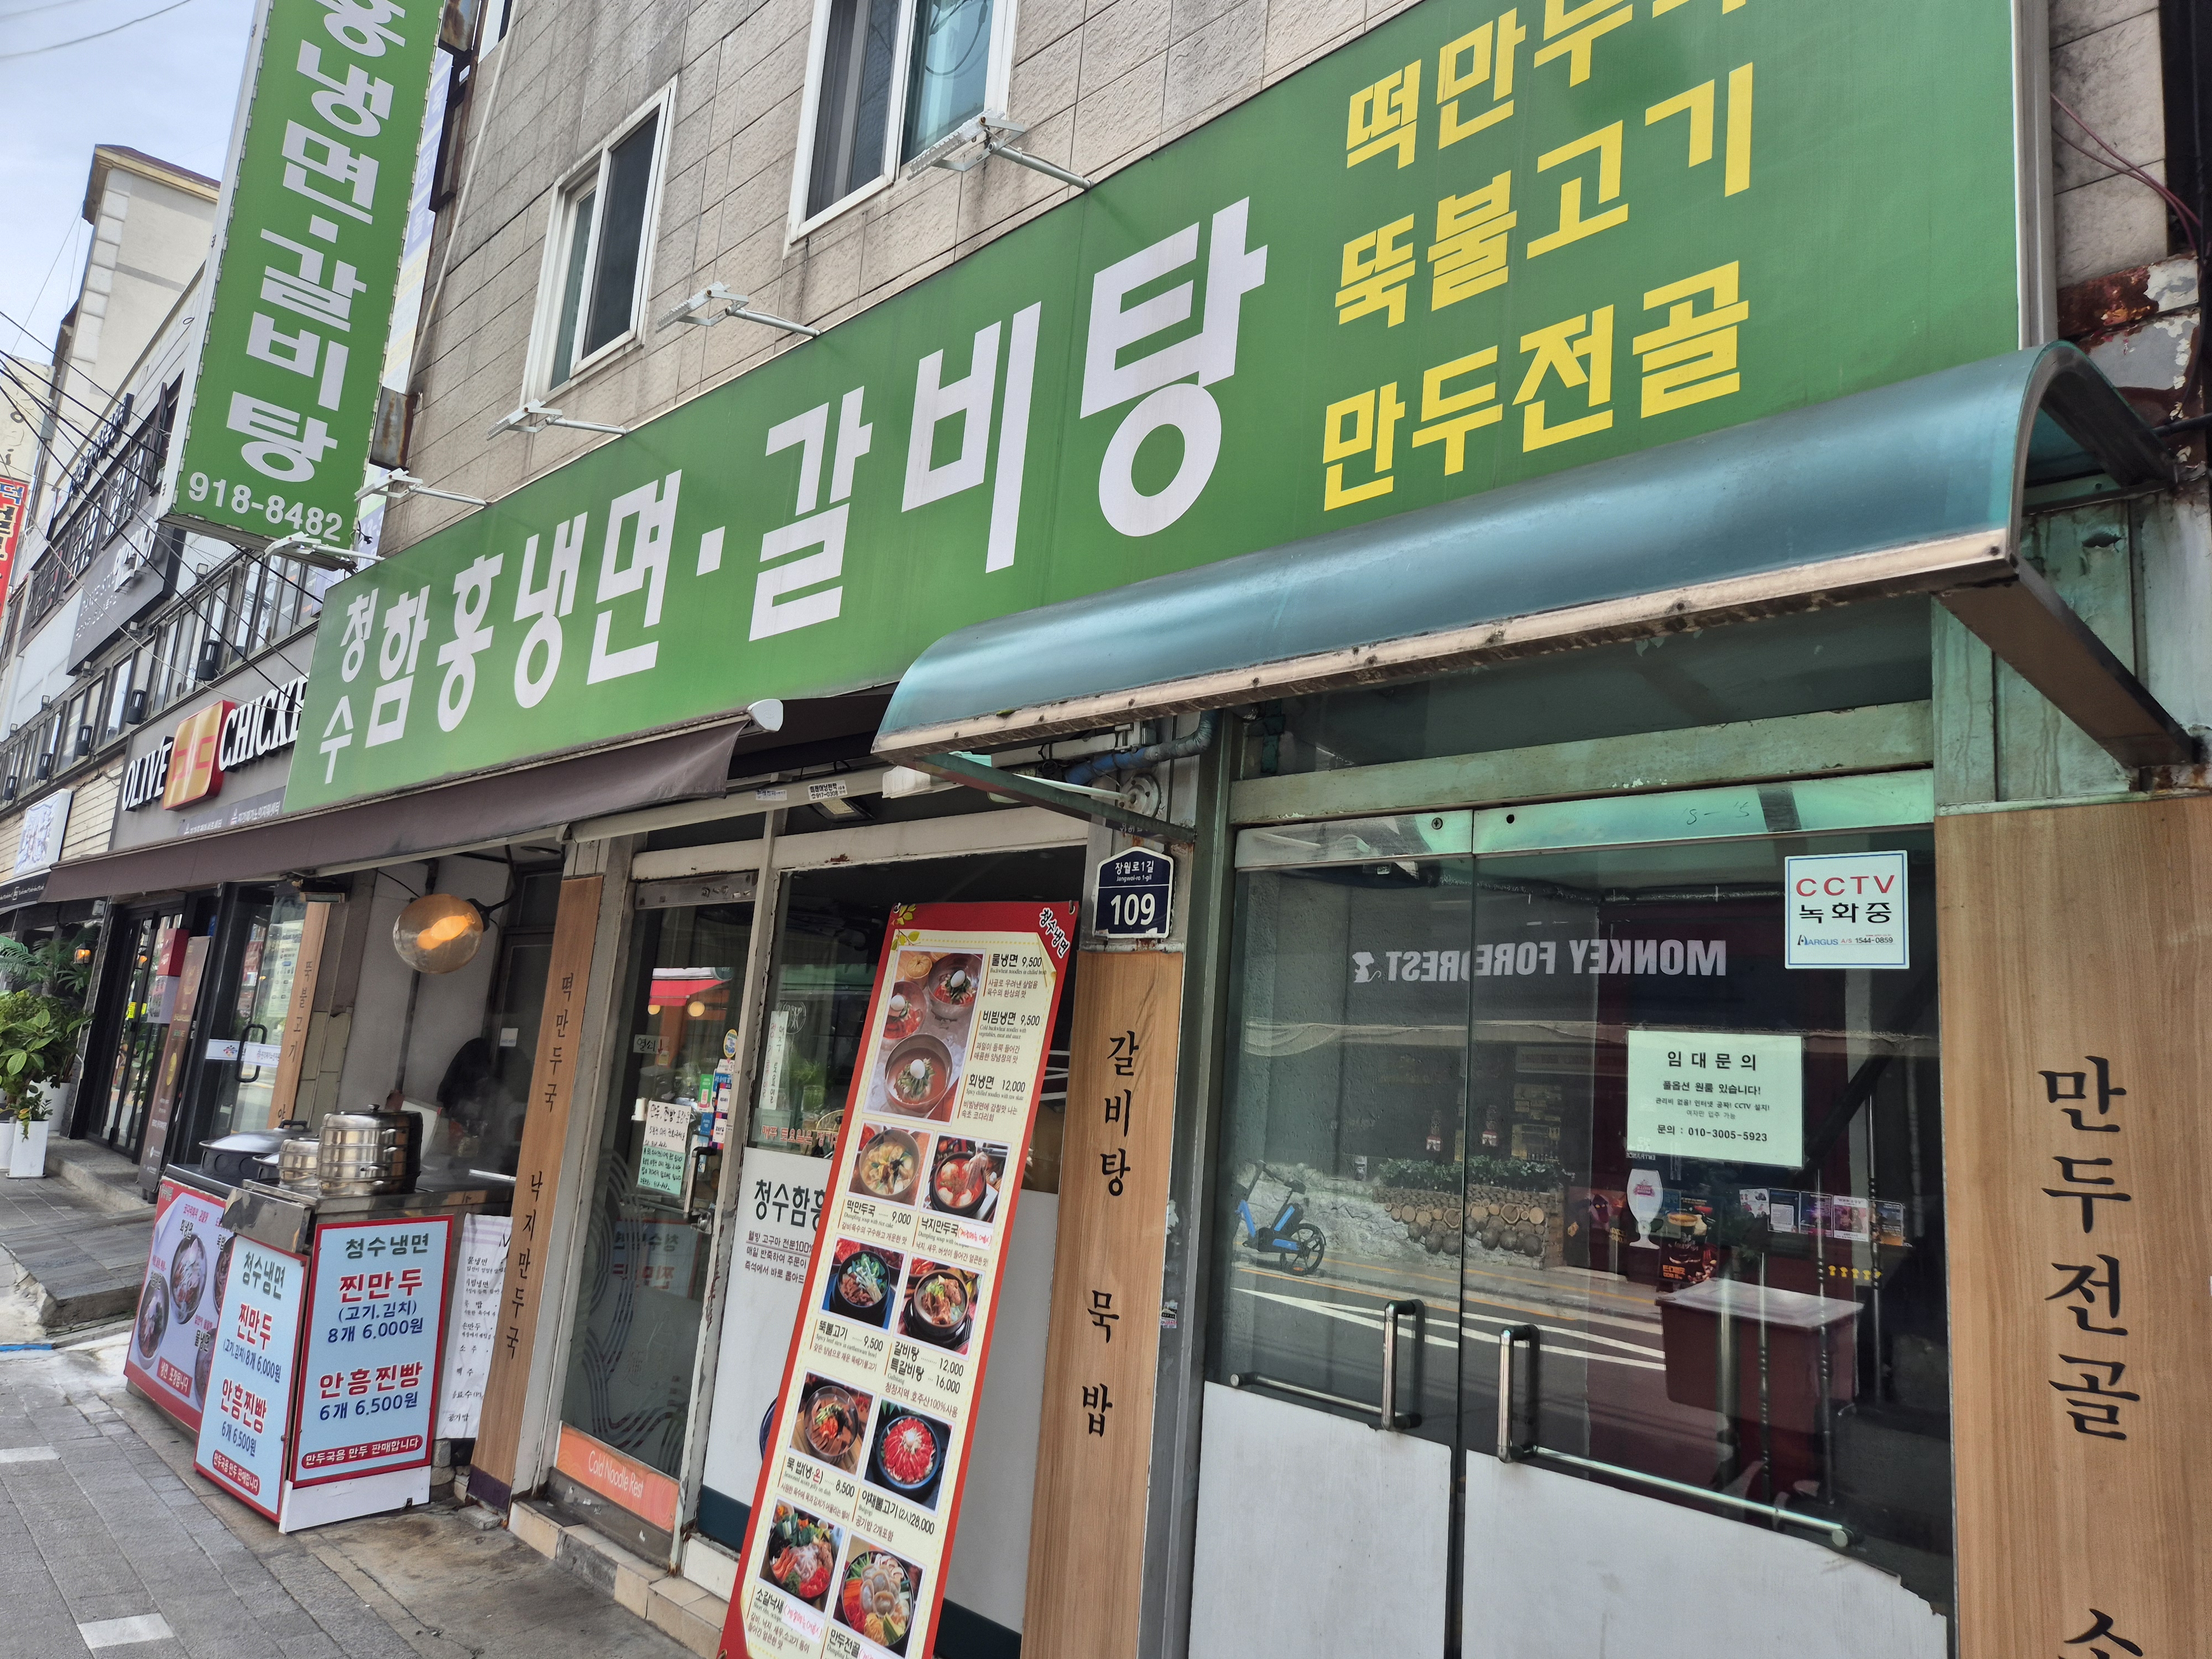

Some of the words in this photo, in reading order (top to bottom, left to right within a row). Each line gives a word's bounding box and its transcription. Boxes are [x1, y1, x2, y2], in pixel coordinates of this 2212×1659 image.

[1347, 0, 1746, 169] 떡만두
[1335, 61, 1753, 328] 뚝불고기
[1323, 260, 1749, 512] 만두전골
[189, 472, 343, 542] 918-8482
[122, 736, 173, 811] OLIVE
[816, 790, 838, 799] 917-0308
[1796, 875, 1895, 896] CCTV
[1110, 893, 1155, 926] 109
[1799, 902, 1892, 924] 녹화중
[1040, 909, 1070, 958] 청수냉면
[992, 953, 1018, 967] 물냉면
[1021, 957, 1042, 968] 9,500
[1021, 990, 1026, 998] 맛
[288, 961, 312, 1062] 뚝불고기
[982, 1010, 1016, 1025] 비빔냉면
[1020, 1014, 1040, 1027] 9,500
[545, 973, 573, 1113] 떡만두국
[637, 1037, 656, 1051] 열쇠
[1013, 1056, 1018, 1064] 맛
[1667, 1051, 1756, 1071] 임대문의
[968, 1073, 994, 1089] 회냉면
[1002, 1079, 1026, 1092] 12,000
[1662, 1081, 1690, 1092] 풀옵션
[1695, 1082, 1714, 1093] 원룸
[1719, 1084, 1761, 1095] 있습니다!
[963, 1100, 989, 1112] 비빔냉면에
[990, 1103, 1006, 1113] 감칠맛
[1008, 1107, 1018, 1115] 나는
[1100, 1030, 1139, 1197] 갈비탕
[1656, 1097, 1673, 1105] 관리비
[961, 1110, 972, 1119] 속초
[973, 1111, 994, 1122] 코다리회
[761, 1125, 778, 1140] 매주
[780, 1128, 813, 1145] 토요일은
[1657, 1124, 1675, 1135] 문의
[1688, 1127, 1767, 1142] 010-3005-5923
[847, 1199, 876, 1217] 떡만두국
[891, 1211, 911, 1225] 9,000
[180, 1219, 194, 1240] 회냉면
[842, 1222, 866, 1234] 갈비육수의
[867, 1227, 885, 1239] 구수하고
[886, 1233, 901, 1244] 개운한
[902, 1236, 907, 1245] 맛
[918, 1230, 936, 1241] Dumpling
[921, 1217, 959, 1237] 낙지만두국
[345, 1233, 429, 1259] 청수냉면
[762, 1234, 781, 1247] 고구마
[2037, 1056, 2141, 1441] 만두전골
[506, 1171, 543, 1360] 낙지만두국
[747, 1246, 759, 1257] 매일
[760, 1249, 785, 1264] 반죽하여
[787, 1255, 807, 1269] 주문이
[938, 1246, 953, 1258] 버섯이
[953, 1250, 968, 1261] 들어간
[969, 1254, 983, 1265] 얼큰한
[243, 1251, 286, 1300] 청수냉면
[745, 1260, 769, 1275] 즉석에서
[771, 1267, 783, 1279] 바로
[339, 1269, 422, 1303] 찐만두
[338, 1300, 417, 1323] (고기.김치)
[237, 1303, 273, 1350] 찐만두
[328, 1326, 356, 1343] 8개
[363, 1317, 424, 1339] 6.000원
[816, 1333, 826, 1343] Spicy
[826, 1335, 834, 1344] beef
[818, 1320, 848, 1340] 뚝불고기
[864, 1335, 884, 1352] 9,500
[195, 1329, 211, 1352] 물냉면
[823, 1346, 841, 1359] 양념으로
[223, 1338, 245, 1363] (고기.김치)
[246, 1349, 256, 1370] 8개
[257, 1355, 281, 1383] 6.000원
[894, 1340, 920, 1362] 갈비탕
[940, 1358, 964, 1376] 12,000
[320, 1361, 423, 1399] 안흥찐빵
[890, 1357, 925, 1382] 특갈비탕
[936, 1375, 961, 1394] 16,000
[885, 1382, 910, 1400] 청정지역
[221, 1379, 267, 1434] 안흥찐빵
[320, 1402, 348, 1421] 6개
[355, 1391, 418, 1416] 6.500원
[222, 1421, 232, 1442] 6개
[233, 1428, 257, 1457] 6.500원
[306, 1449, 346, 1466] 만두국용
[348, 1446, 368, 1459] 만두
[372, 1437, 419, 1454] 판매합니다
[213, 1452, 229, 1473] 만두국용
[229, 1463, 237, 1479] 만두
[238, 1469, 258, 1492] 판매합니다
[588, 1451, 604, 1477] Cold
[604, 1461, 629, 1491] Noodle
[629, 1472, 644, 1499] Rest
[836, 1479, 855, 1498] 8,500
[862, 1490, 899, 1519] 야채불고기
[910, 1513, 935, 1535] 28,000
[855, 1515, 873, 1532] 공기밥
[873, 1524, 894, 1542] 2개포함
[755, 1588, 784, 1614] 소갈낙새
[778, 1640, 783, 1651] 맛
[830, 1629, 860, 1658] 만두전골
